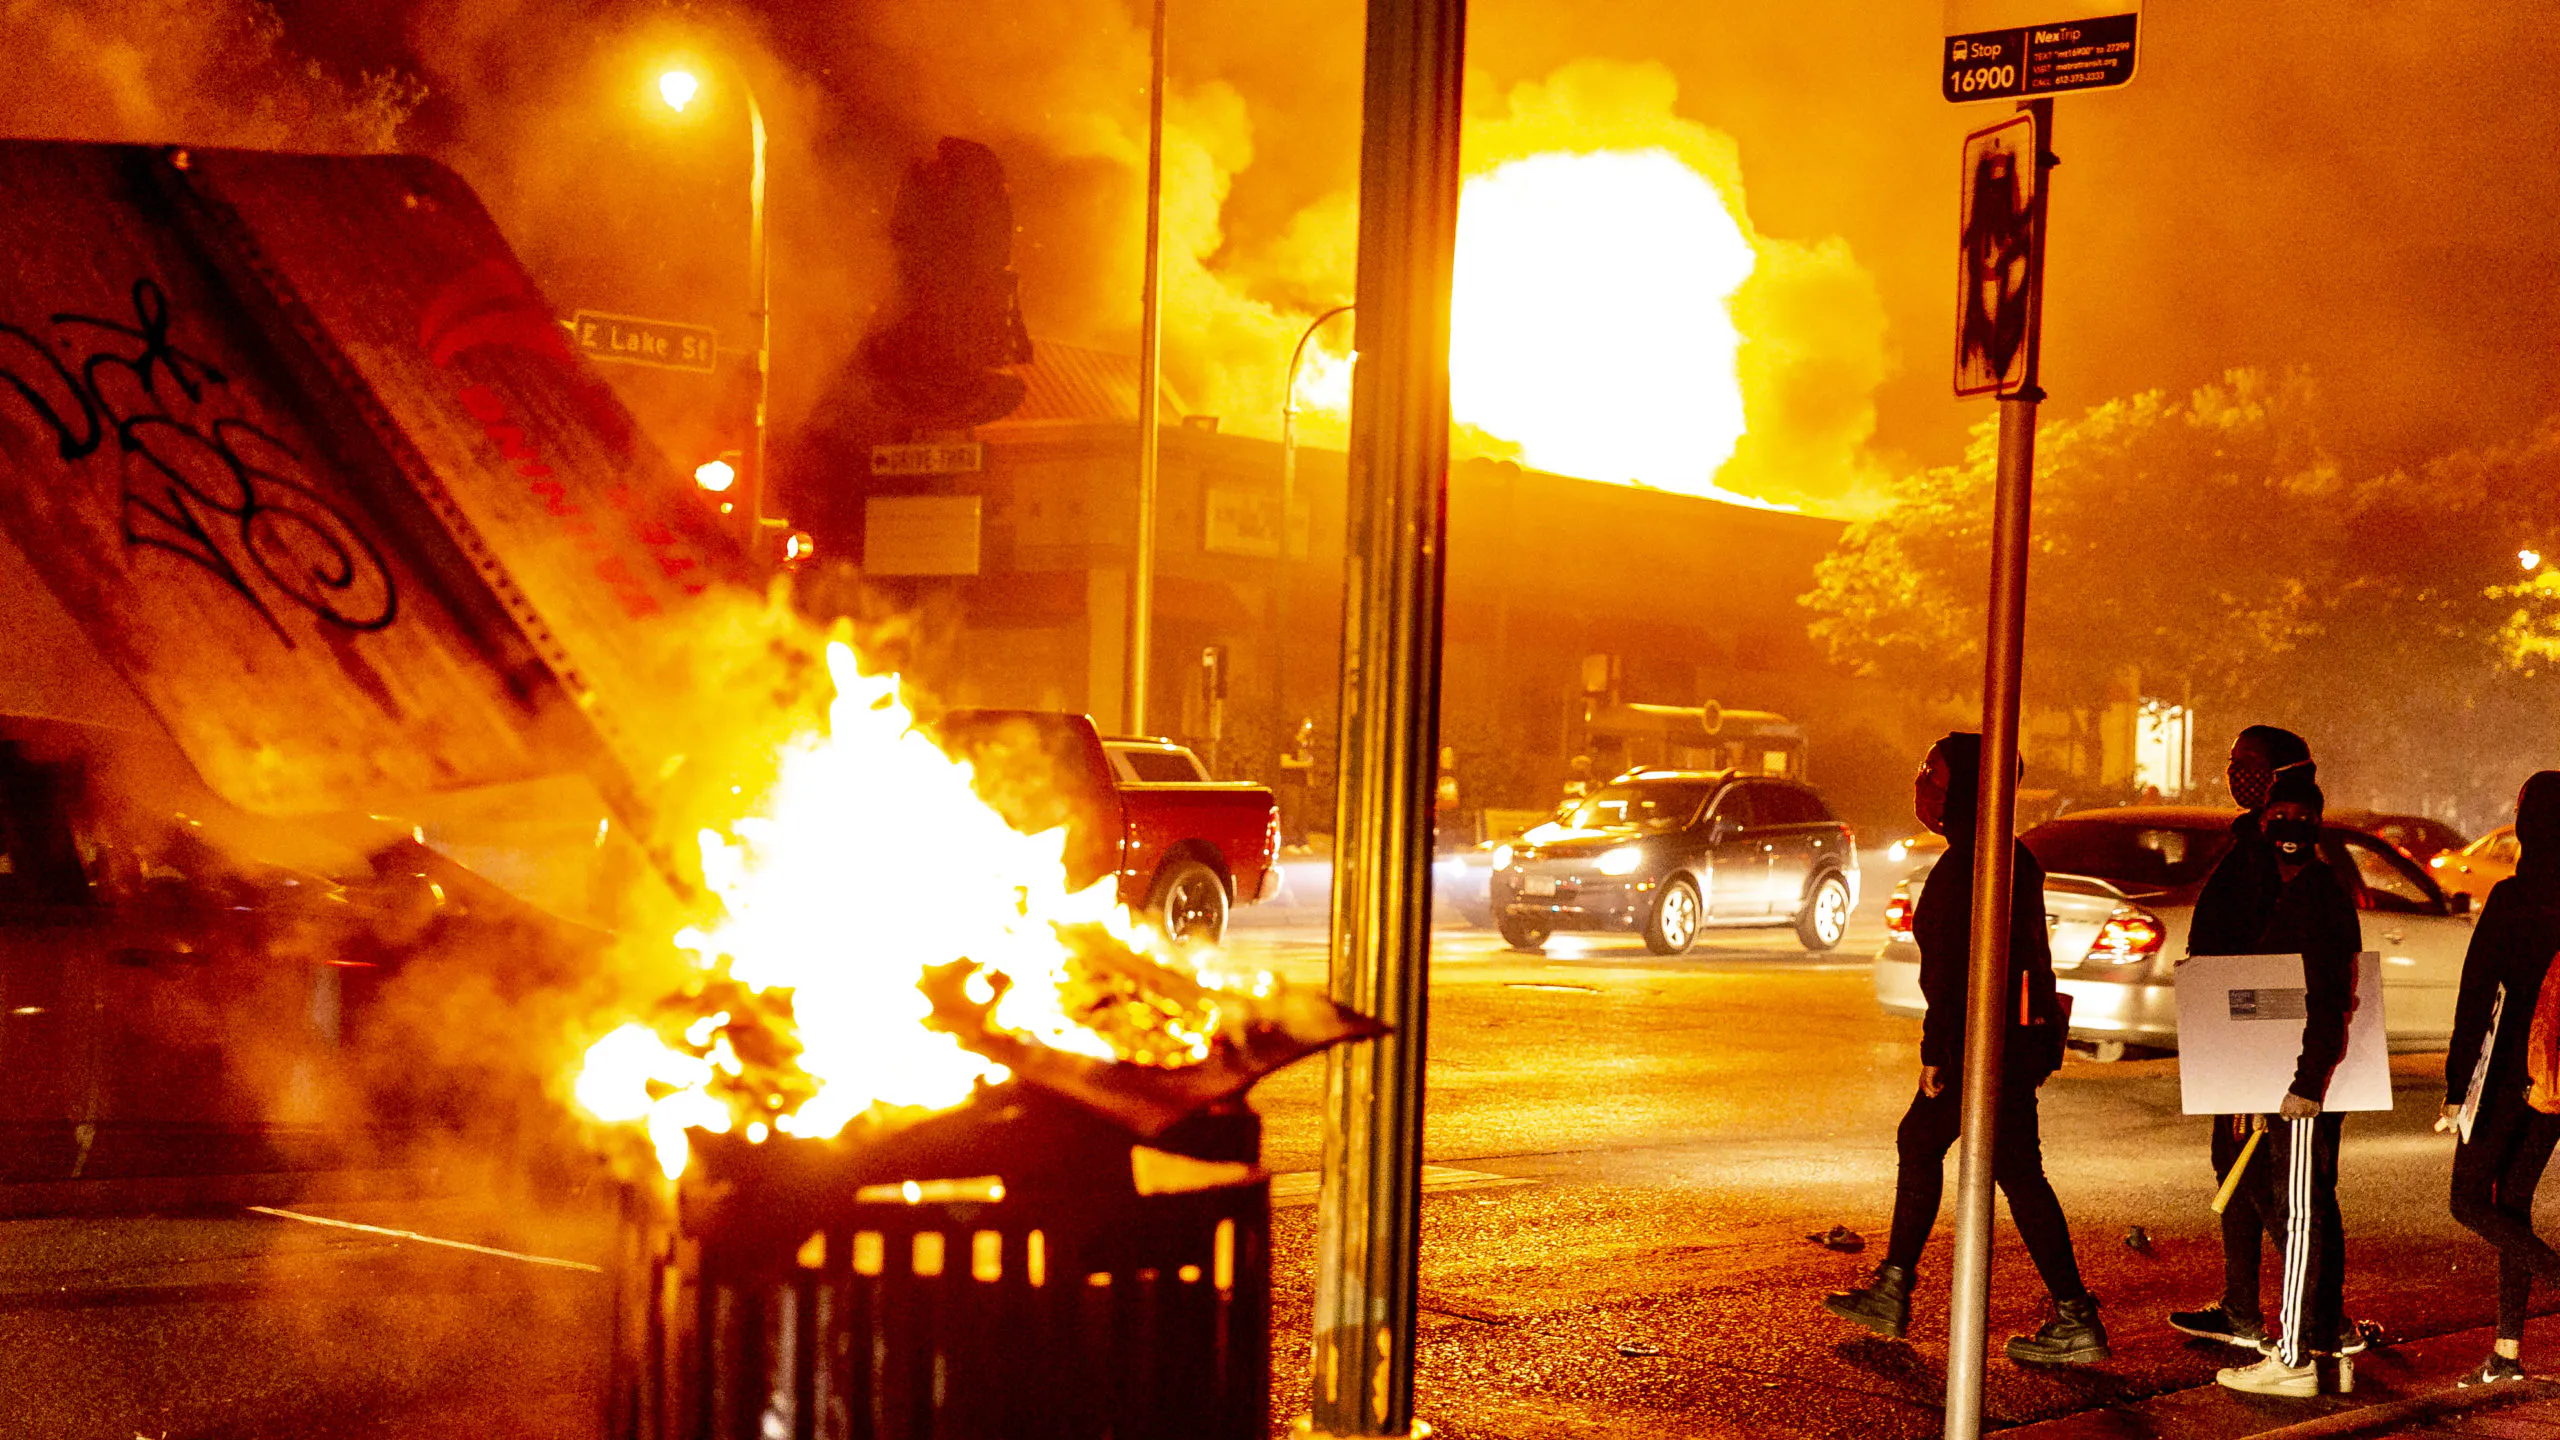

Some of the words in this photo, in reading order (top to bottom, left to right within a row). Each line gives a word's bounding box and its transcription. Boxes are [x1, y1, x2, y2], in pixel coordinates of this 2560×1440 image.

[2034, 27, 2081, 44] NexTrip
[1971, 42, 2002, 61] Stop
[2033, 51, 2053, 61] TEXT
[1951, 64, 2015, 94] 16900
[581, 322, 598, 348] E
[610, 324, 669, 357] Lake
[682, 335, 709, 362] St
